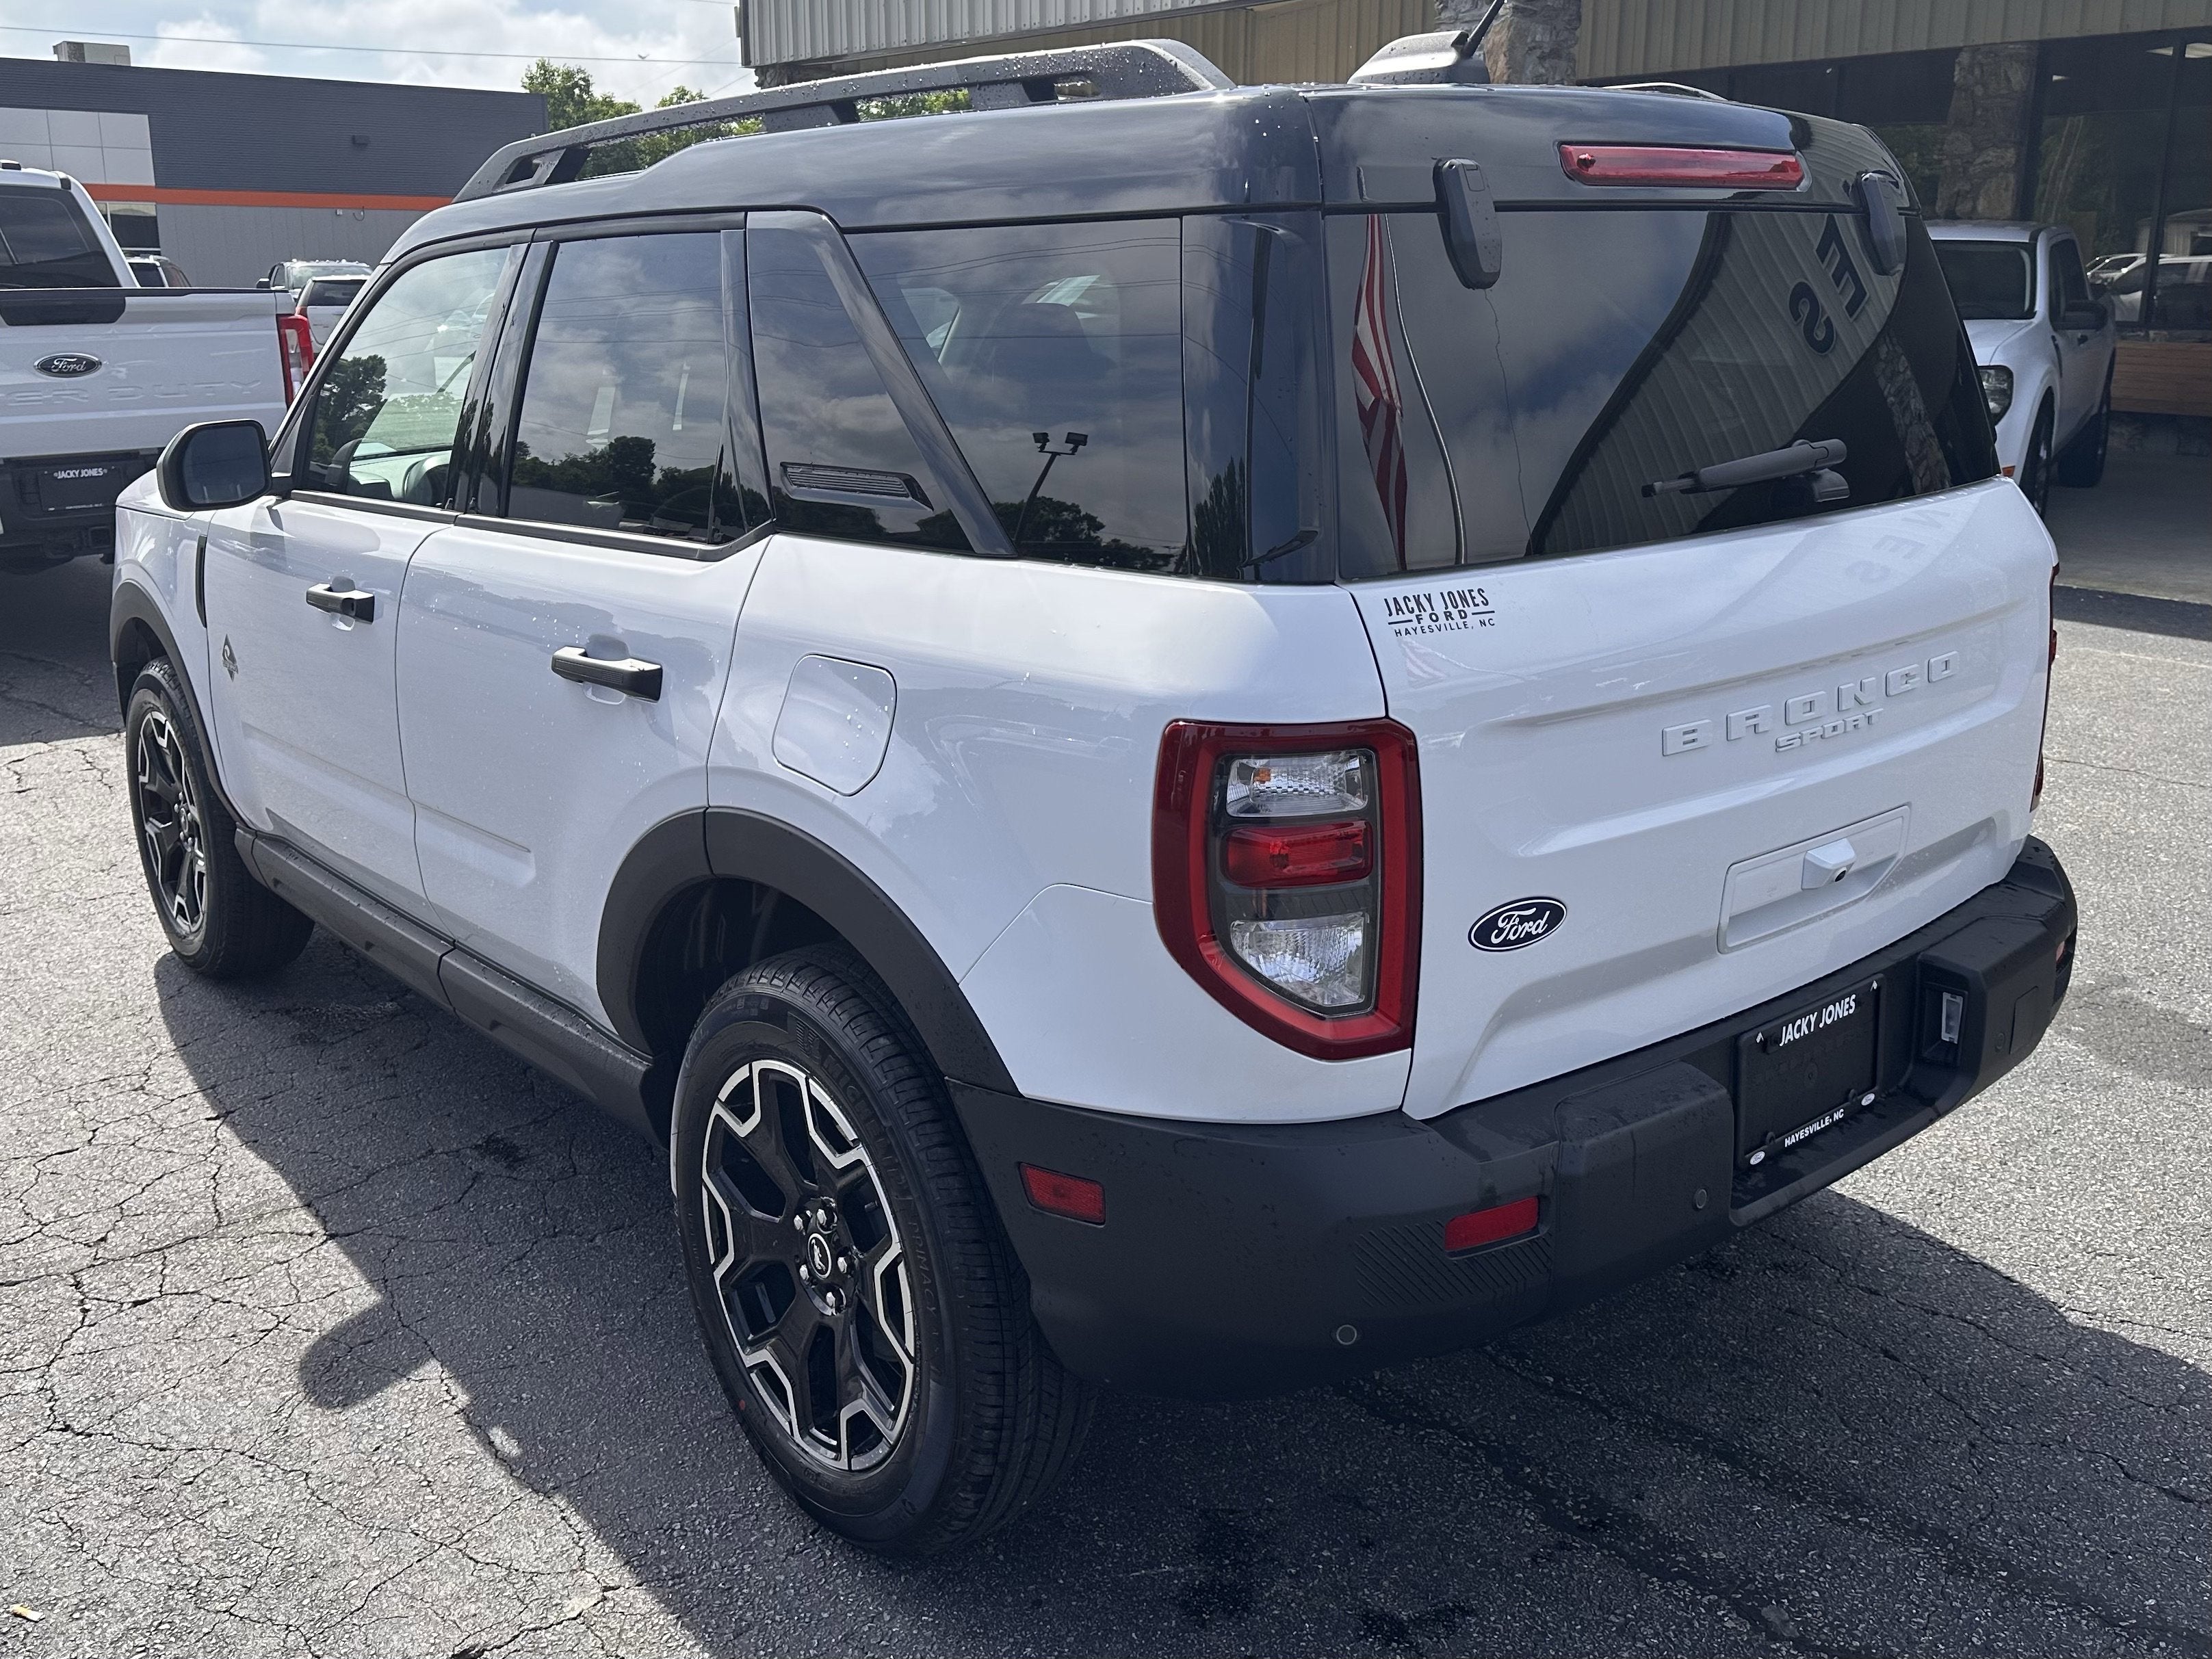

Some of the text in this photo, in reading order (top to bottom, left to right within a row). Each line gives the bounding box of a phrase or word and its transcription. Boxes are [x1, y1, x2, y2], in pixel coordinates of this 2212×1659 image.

[57, 467, 104, 479] JACKY JONES
[1383, 588, 1489, 617] JACKY JONES
[1416, 609, 1468, 624] FORD
[1394, 618, 1496, 637] HAYESVILLE, NC
[1662, 651, 1960, 757] BRONCO
[1775, 708, 1884, 753] SPORT
[1779, 994, 1856, 1047] JACKY JONES
[1784, 1108, 1845, 1147] HAYESVILLE, NC
